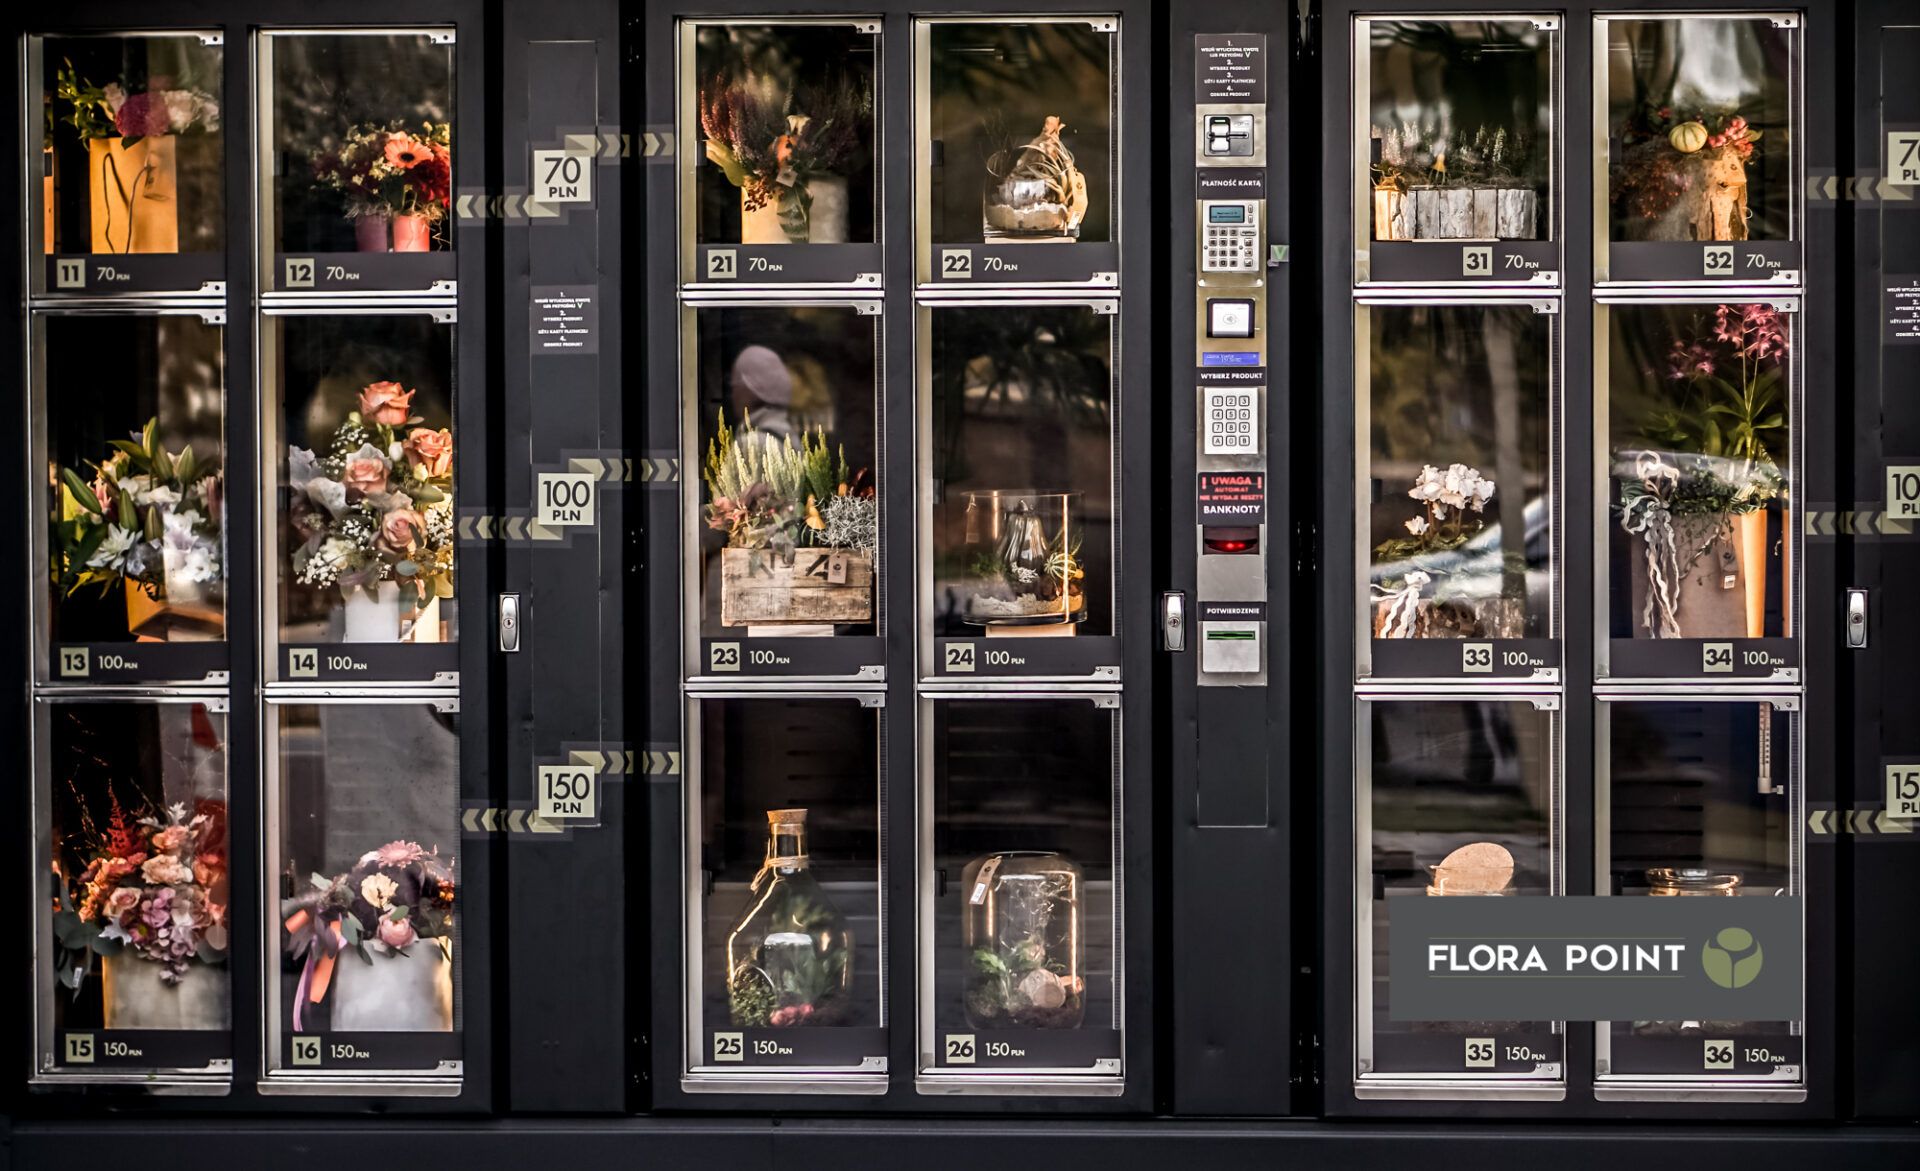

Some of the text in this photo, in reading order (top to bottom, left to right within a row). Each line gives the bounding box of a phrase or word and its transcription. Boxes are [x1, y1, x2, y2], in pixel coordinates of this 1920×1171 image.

[1900, 140, 1920, 167] 7
[544, 157, 581, 184] 70
[1903, 169, 1920, 180] PL
[549, 187, 577, 198] PLN
[712, 256, 732, 272] 21
[749, 258, 767, 271] 70
[944, 255, 969, 272] 22
[984, 258, 1002, 271] 70
[1467, 253, 1487, 269] 31
[1505, 255, 1523, 268] 70
[1706, 252, 1732, 268] 32
[1747, 254, 1765, 268] 70
[62, 265, 79, 282] 11
[97, 267, 115, 280] 70
[290, 265, 311, 281] 12
[327, 267, 344, 280] 70
[1211, 477, 1252, 485] UWAGA
[1892, 473, 1920, 500] 10
[543, 481, 590, 507] 100
[553, 510, 580, 520] PLN
[1204, 505, 1260, 514] BANKNOTY
[1902, 503, 1920, 514] PL
[64, 654, 85, 670] 13
[99, 656, 122, 669] 100
[293, 654, 315, 670] 14
[713, 648, 738, 664] 23
[750, 651, 775, 664] 100
[948, 649, 973, 665] 24
[985, 651, 1009, 664] 100
[1465, 649, 1490, 666] 33
[1503, 652, 1528, 665] 100
[1705, 649, 1731, 665] 34
[1743, 652, 1768, 665] 100
[328, 657, 352, 669] 100
[544, 773, 590, 800] 150
[1892, 772, 1920, 799] 15
[554, 802, 581, 813] PLN
[1902, 802, 1920, 813] PL
[71, 1041, 91, 1056] 15
[104, 1043, 127, 1056] 150
[296, 1043, 318, 1059] 16
[331, 1045, 354, 1058] 150
[717, 1038, 741, 1054] 25
[754, 1041, 777, 1054] 150
[948, 1041, 973, 1057] 26
[986, 1043, 1009, 1056] 150
[1468, 1044, 1493, 1060] 35
[1506, 1047, 1530, 1060] 150
[1706, 1046, 1732, 1063] 36
[1745, 1049, 1769, 1062] 150
